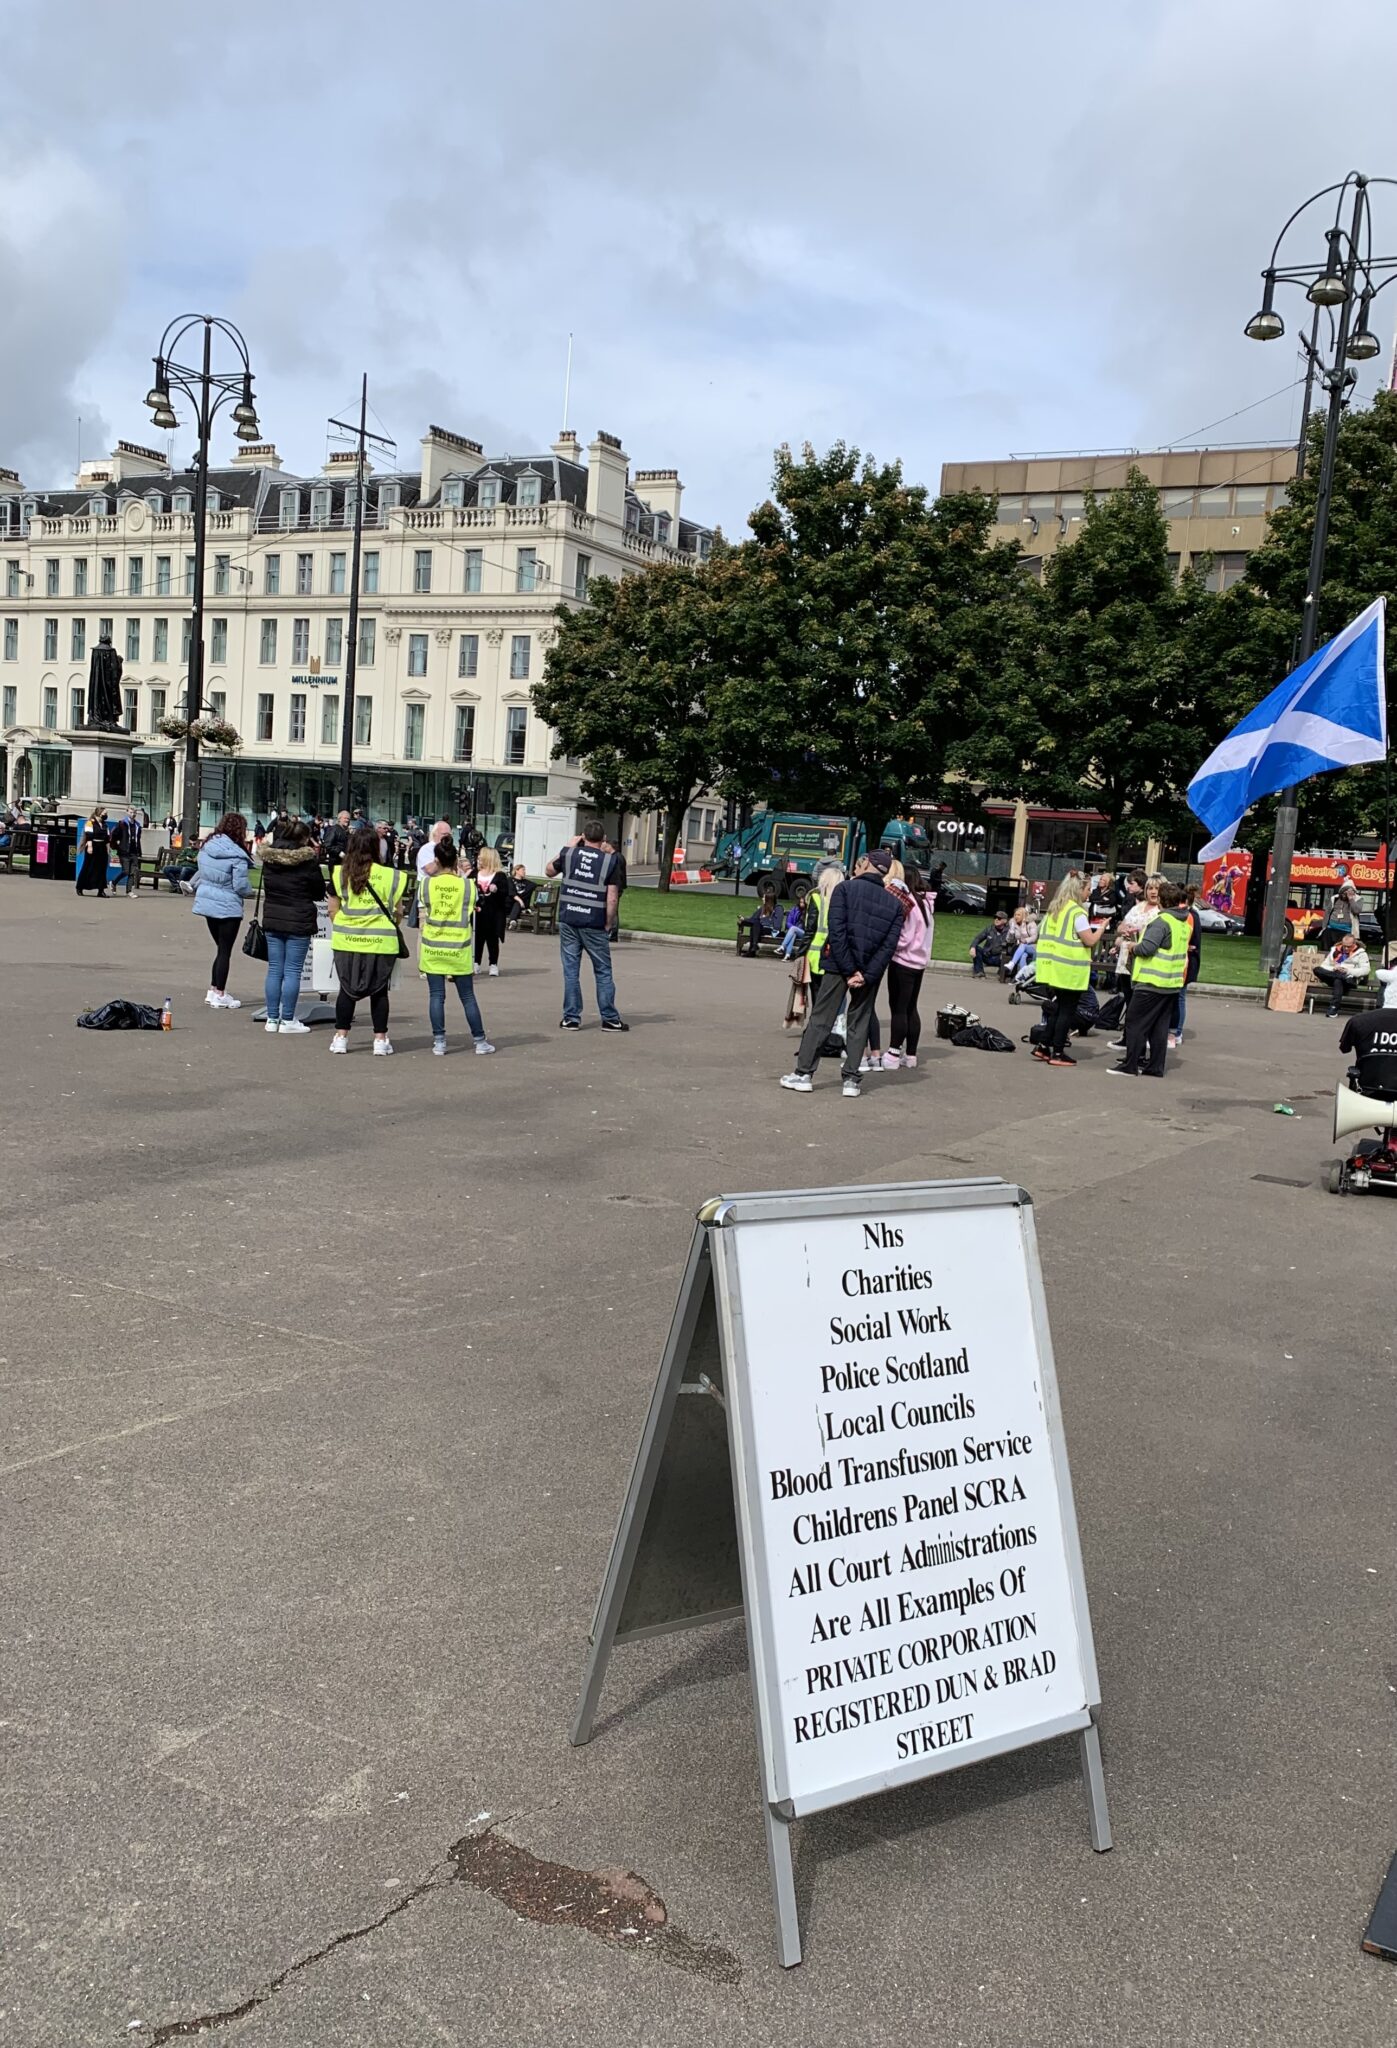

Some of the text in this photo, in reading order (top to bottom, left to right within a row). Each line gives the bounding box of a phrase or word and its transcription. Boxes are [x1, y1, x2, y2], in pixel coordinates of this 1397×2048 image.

[292, 675, 338, 685] MILLENNIUM
[937, 820, 985, 836] COSTA
[578, 849, 599, 858] People
[574, 869, 595, 878] People
[1290, 863, 1395, 883] ightseeing Glasgo
[435, 885, 459, 893] People
[434, 909, 457, 918] People
[566, 904, 591, 914] Scotland
[345, 935, 384, 944] Worldwide
[424, 948, 461, 957] Worldwide
[1373, 1032, 1379, 1044] I
[863, 1223, 903, 1249] Nhs
[842, 1264, 932, 1296] Charities
[831, 1306, 951, 1344] Social Work
[820, 1348, 969, 1393] Police Scotland
[825, 1393, 975, 1440] Local Councils
[770, 1462, 832, 1500] Blood
[964, 1431, 1031, 1464] Service
[794, 1475, 1026, 1544] Childrens Panel SCRA
[789, 1524, 1036, 1597] All Court Administrations
[811, 1566, 1025, 1643] Are All Examples Of
[806, 1613, 1036, 1694] PRIVATE CORPORATION
[794, 1650, 1055, 1743] REGISTERED DUN & BRAD
[897, 1714, 973, 1759] STREET
